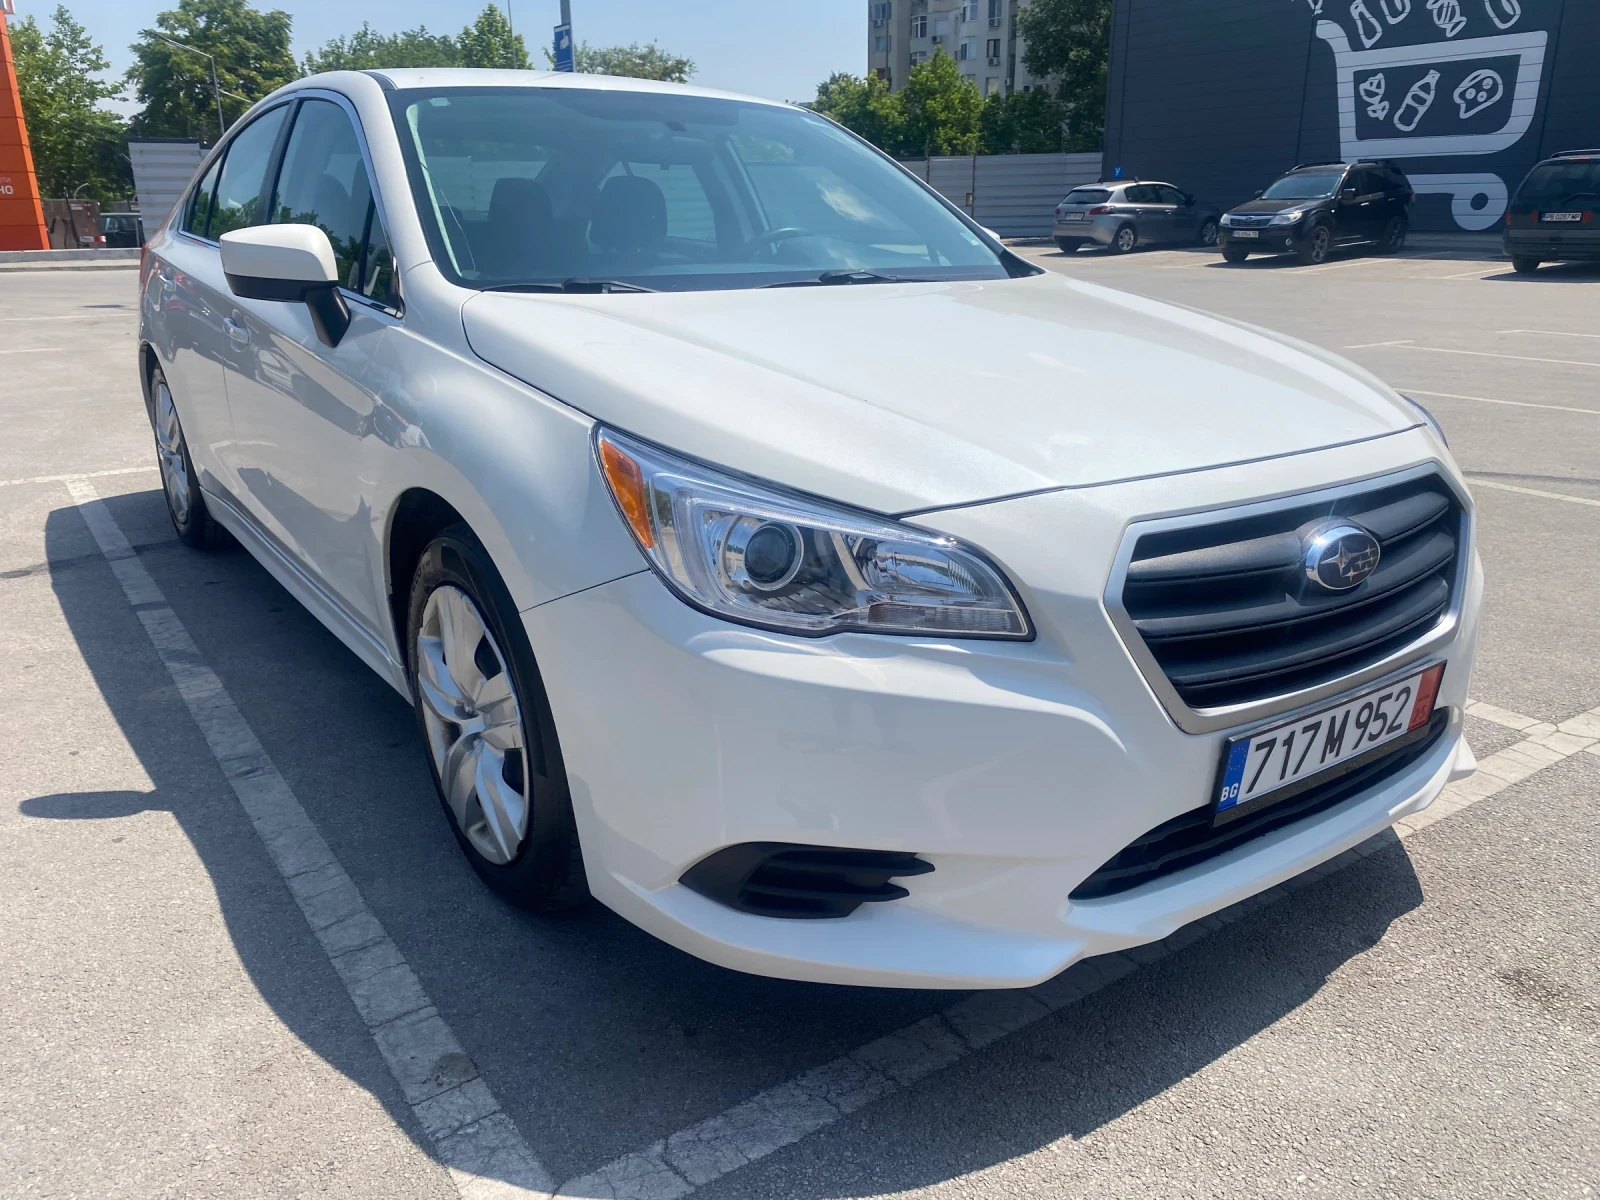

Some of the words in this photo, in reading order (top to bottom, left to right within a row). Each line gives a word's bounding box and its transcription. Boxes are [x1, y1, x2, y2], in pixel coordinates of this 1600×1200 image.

[1246, 720, 1322, 794] 717
[1320, 709, 1350, 764] M
[1352, 686, 1411, 750] 952
[1221, 783, 1239, 802] BG
